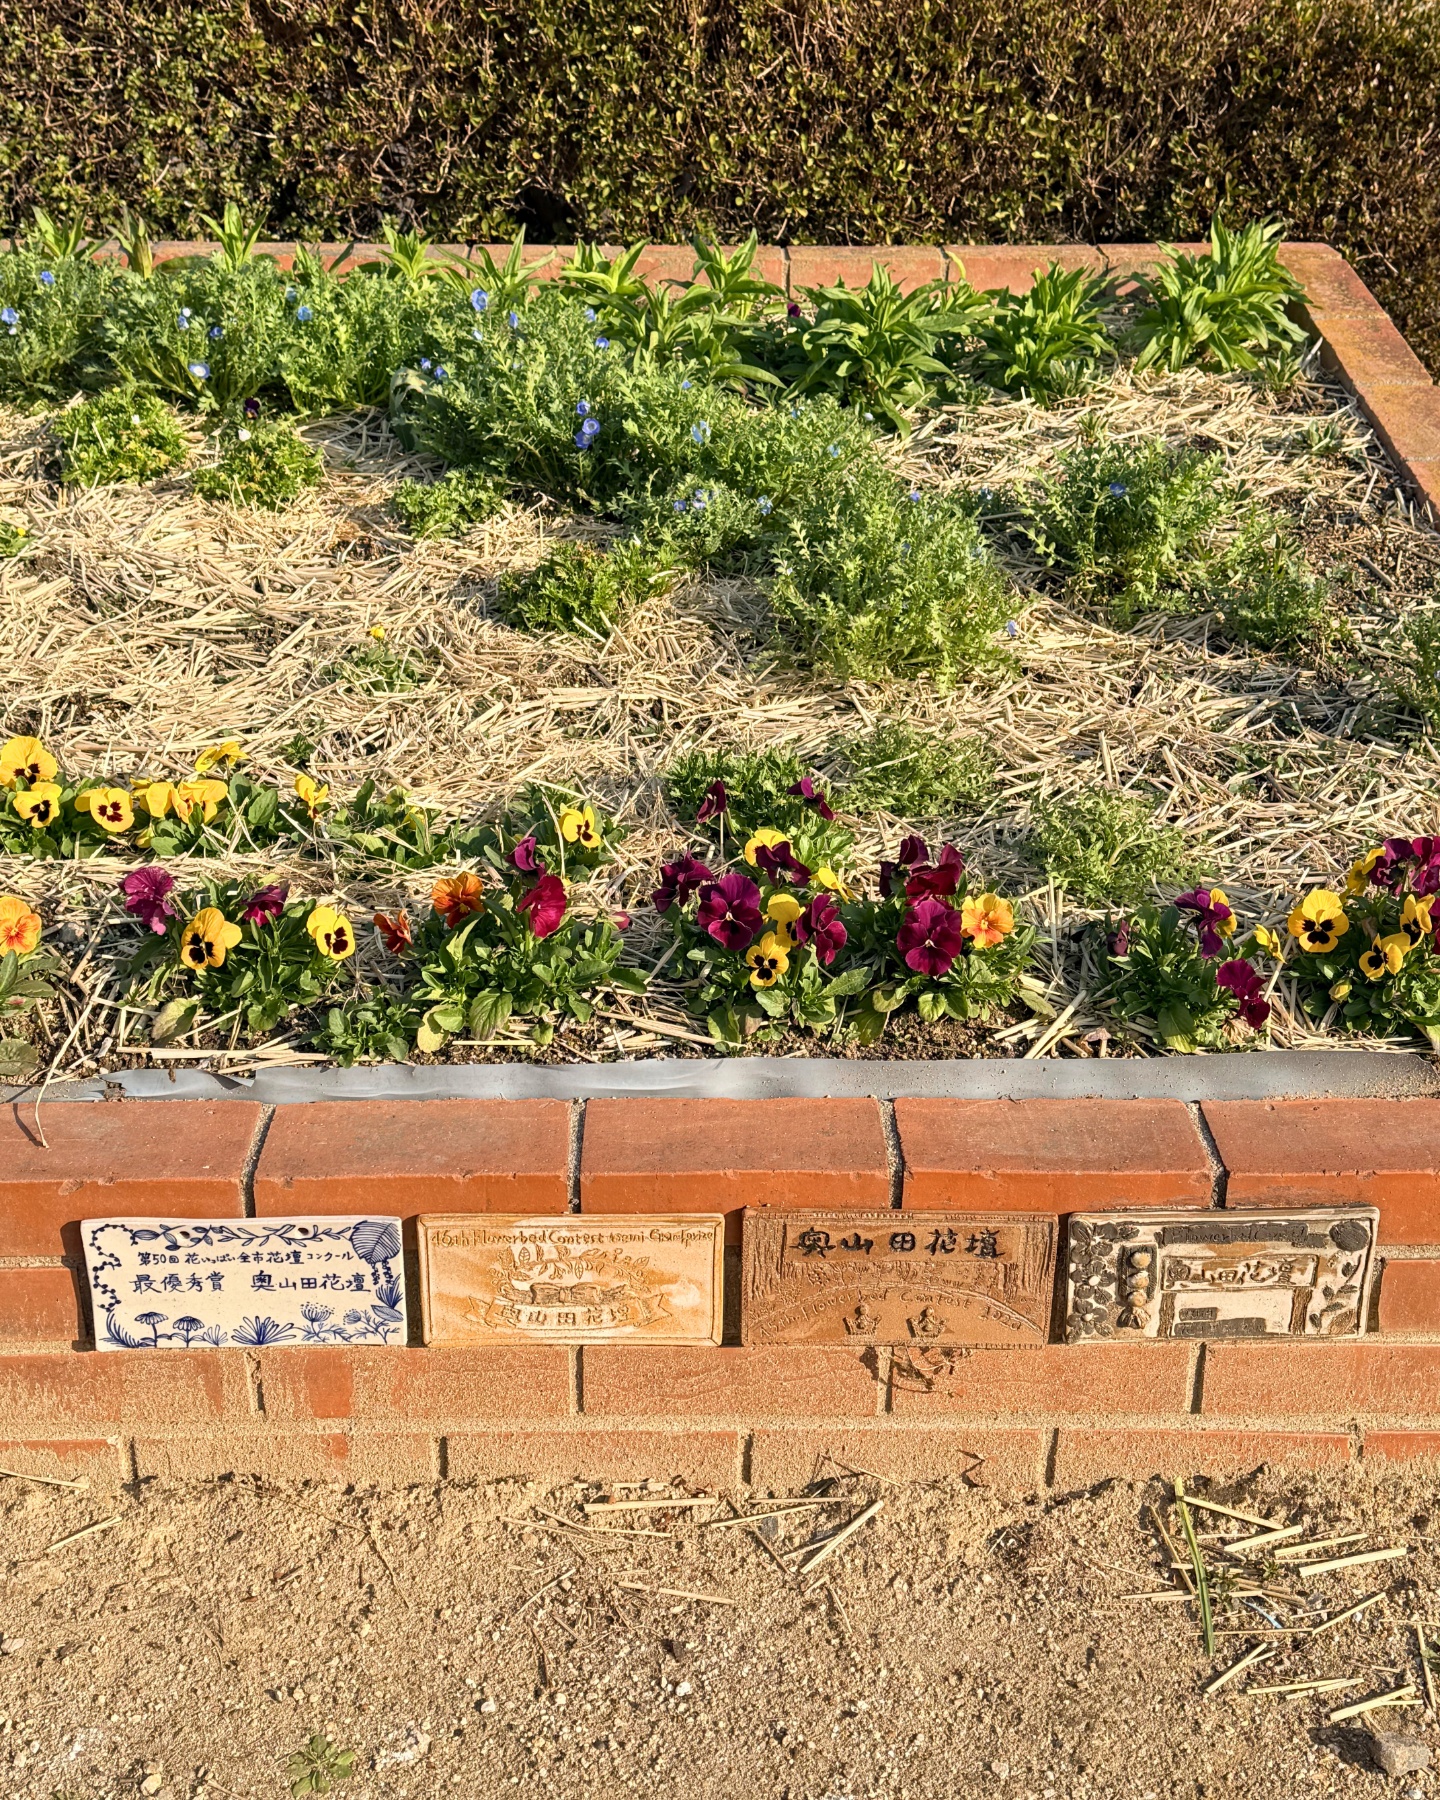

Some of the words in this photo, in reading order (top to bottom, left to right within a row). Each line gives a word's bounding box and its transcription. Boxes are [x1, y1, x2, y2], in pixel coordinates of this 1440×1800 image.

[788, 1226, 1006, 1260] 奥山田花壇
[128, 1270, 225, 1294] 最優秀賞
[250, 1269, 372, 1293] 奥山田花壇
